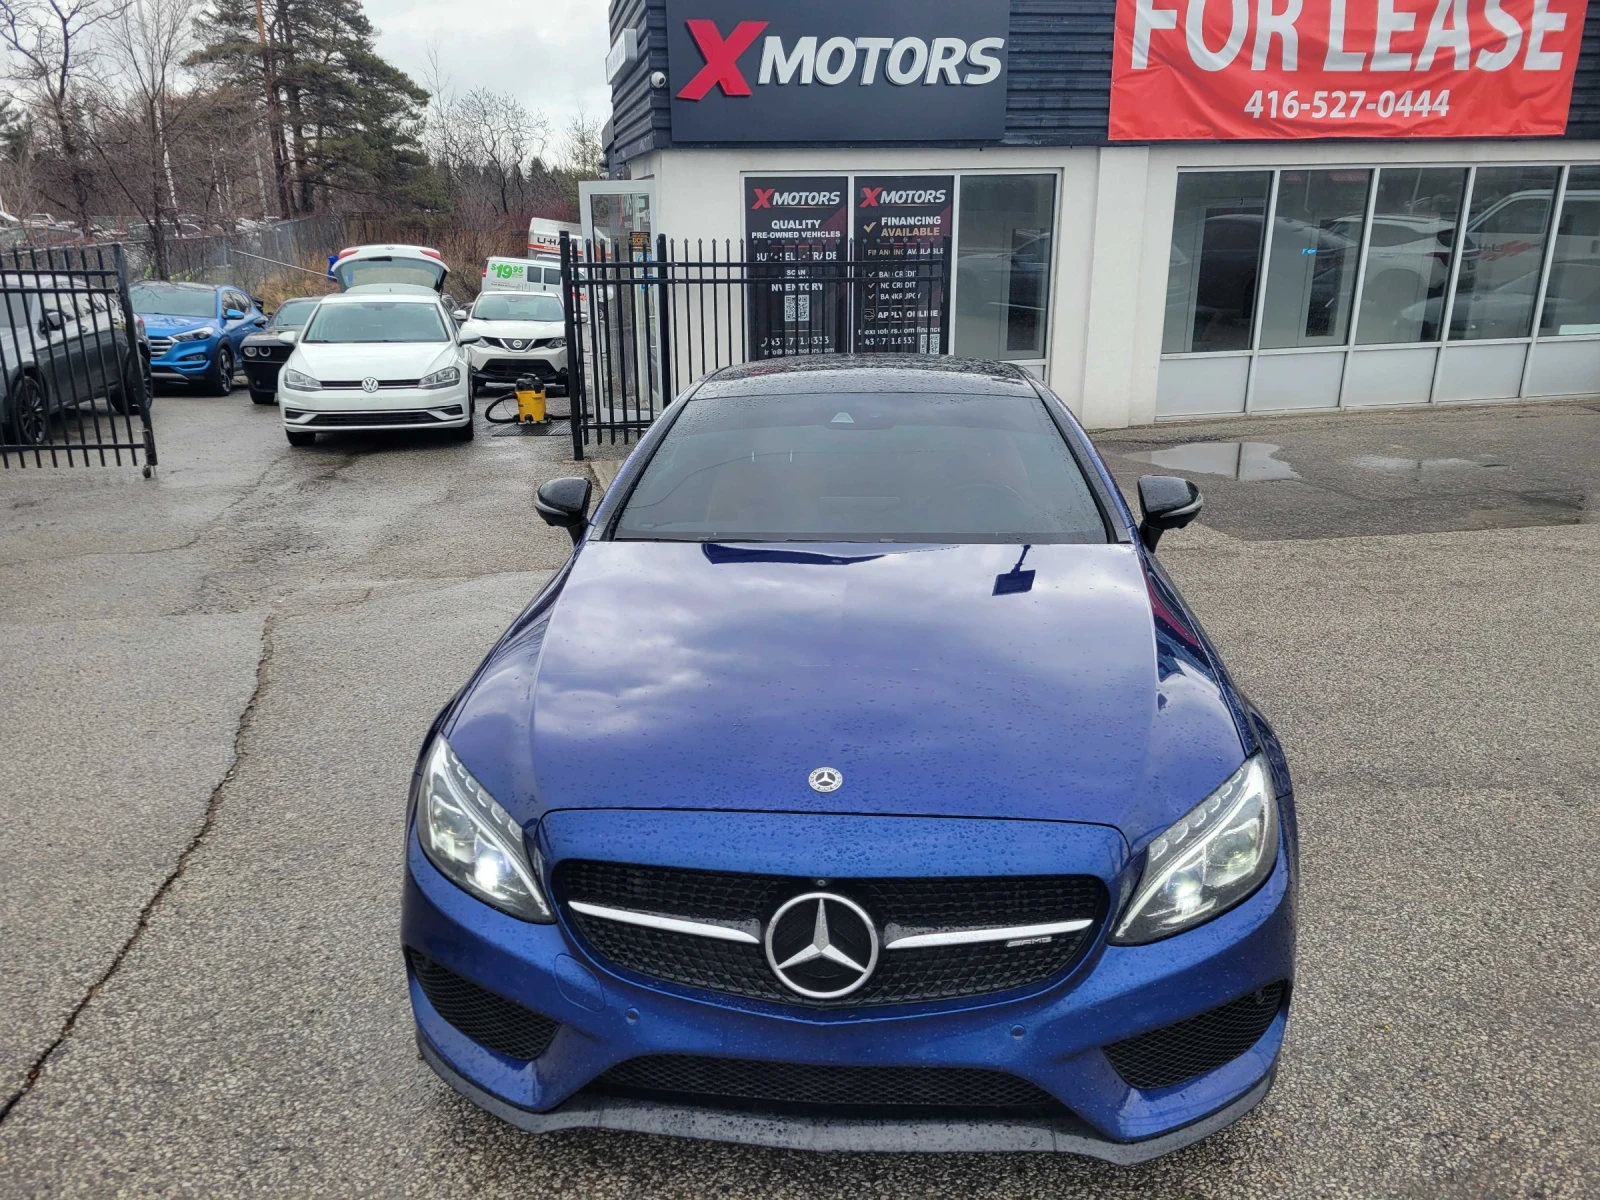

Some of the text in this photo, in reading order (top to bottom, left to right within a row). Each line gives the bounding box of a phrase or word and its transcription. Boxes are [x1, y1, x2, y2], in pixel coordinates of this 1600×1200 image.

[1131, 0, 1567, 72] FOR LEASE
[1244, 89, 1450, 119] 416-527-0444
[771, 219, 821, 230] QUALITY
[881, 216, 942, 226] FINANCING
[751, 230, 841, 239] PRE-OWNED VEHICLES
[880, 227, 941, 237] AVAILABLE
